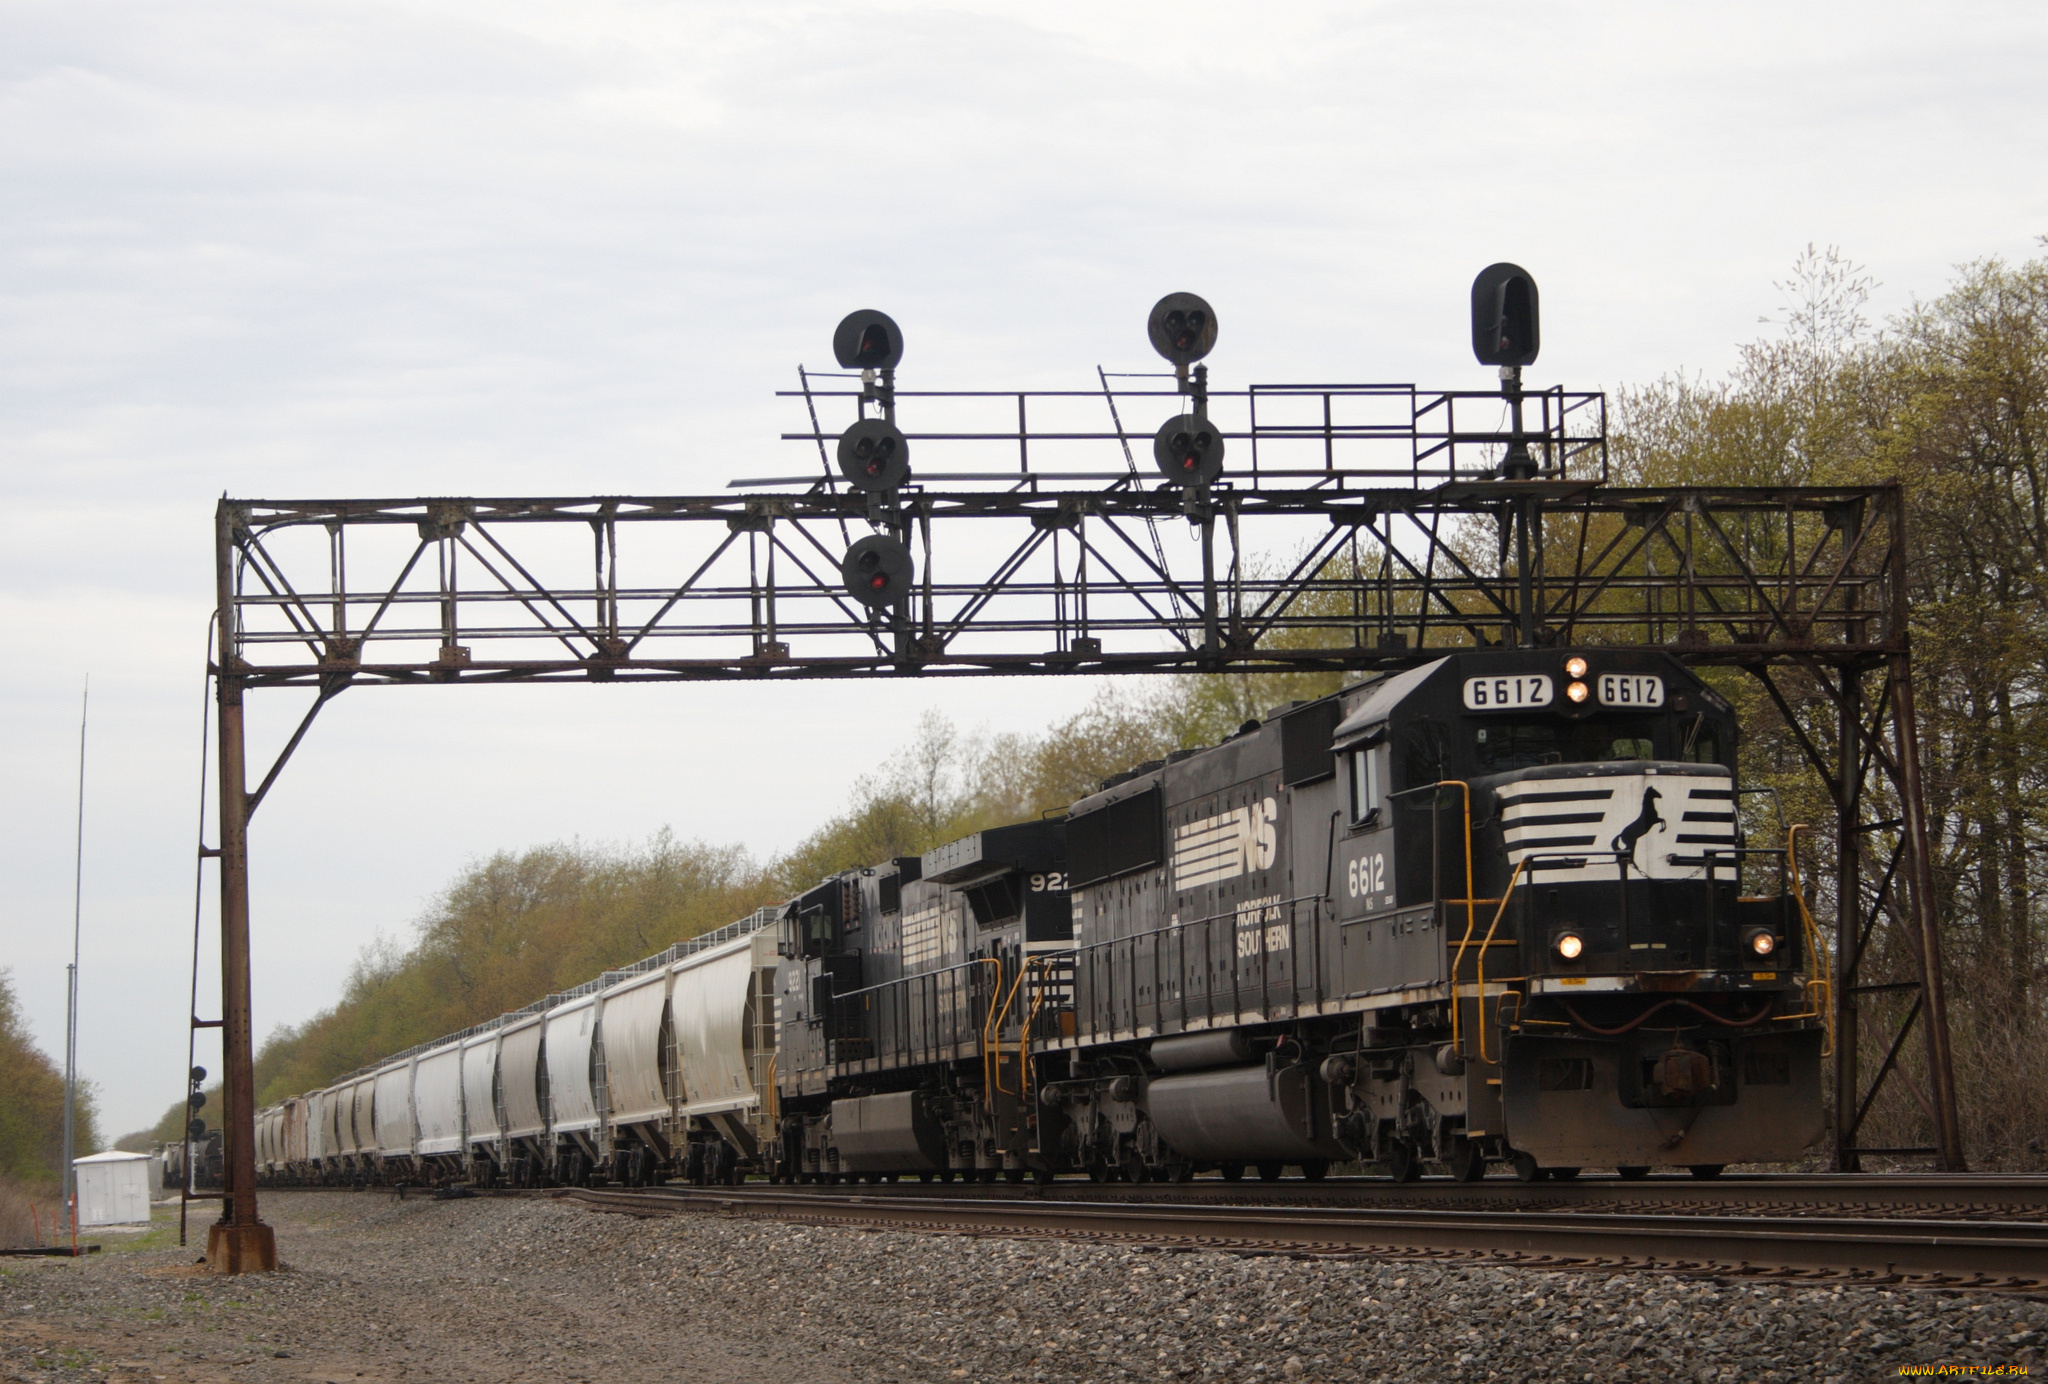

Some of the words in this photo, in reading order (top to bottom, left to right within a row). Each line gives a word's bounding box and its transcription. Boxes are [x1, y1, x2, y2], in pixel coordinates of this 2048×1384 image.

[1473, 678, 1544, 705] 6612
[1604, 677, 1657, 703] 6612
[1237, 796, 1278, 875] NS
[1348, 853, 1385, 898] 6612
[1236, 894, 1282, 927] NORFOLK
